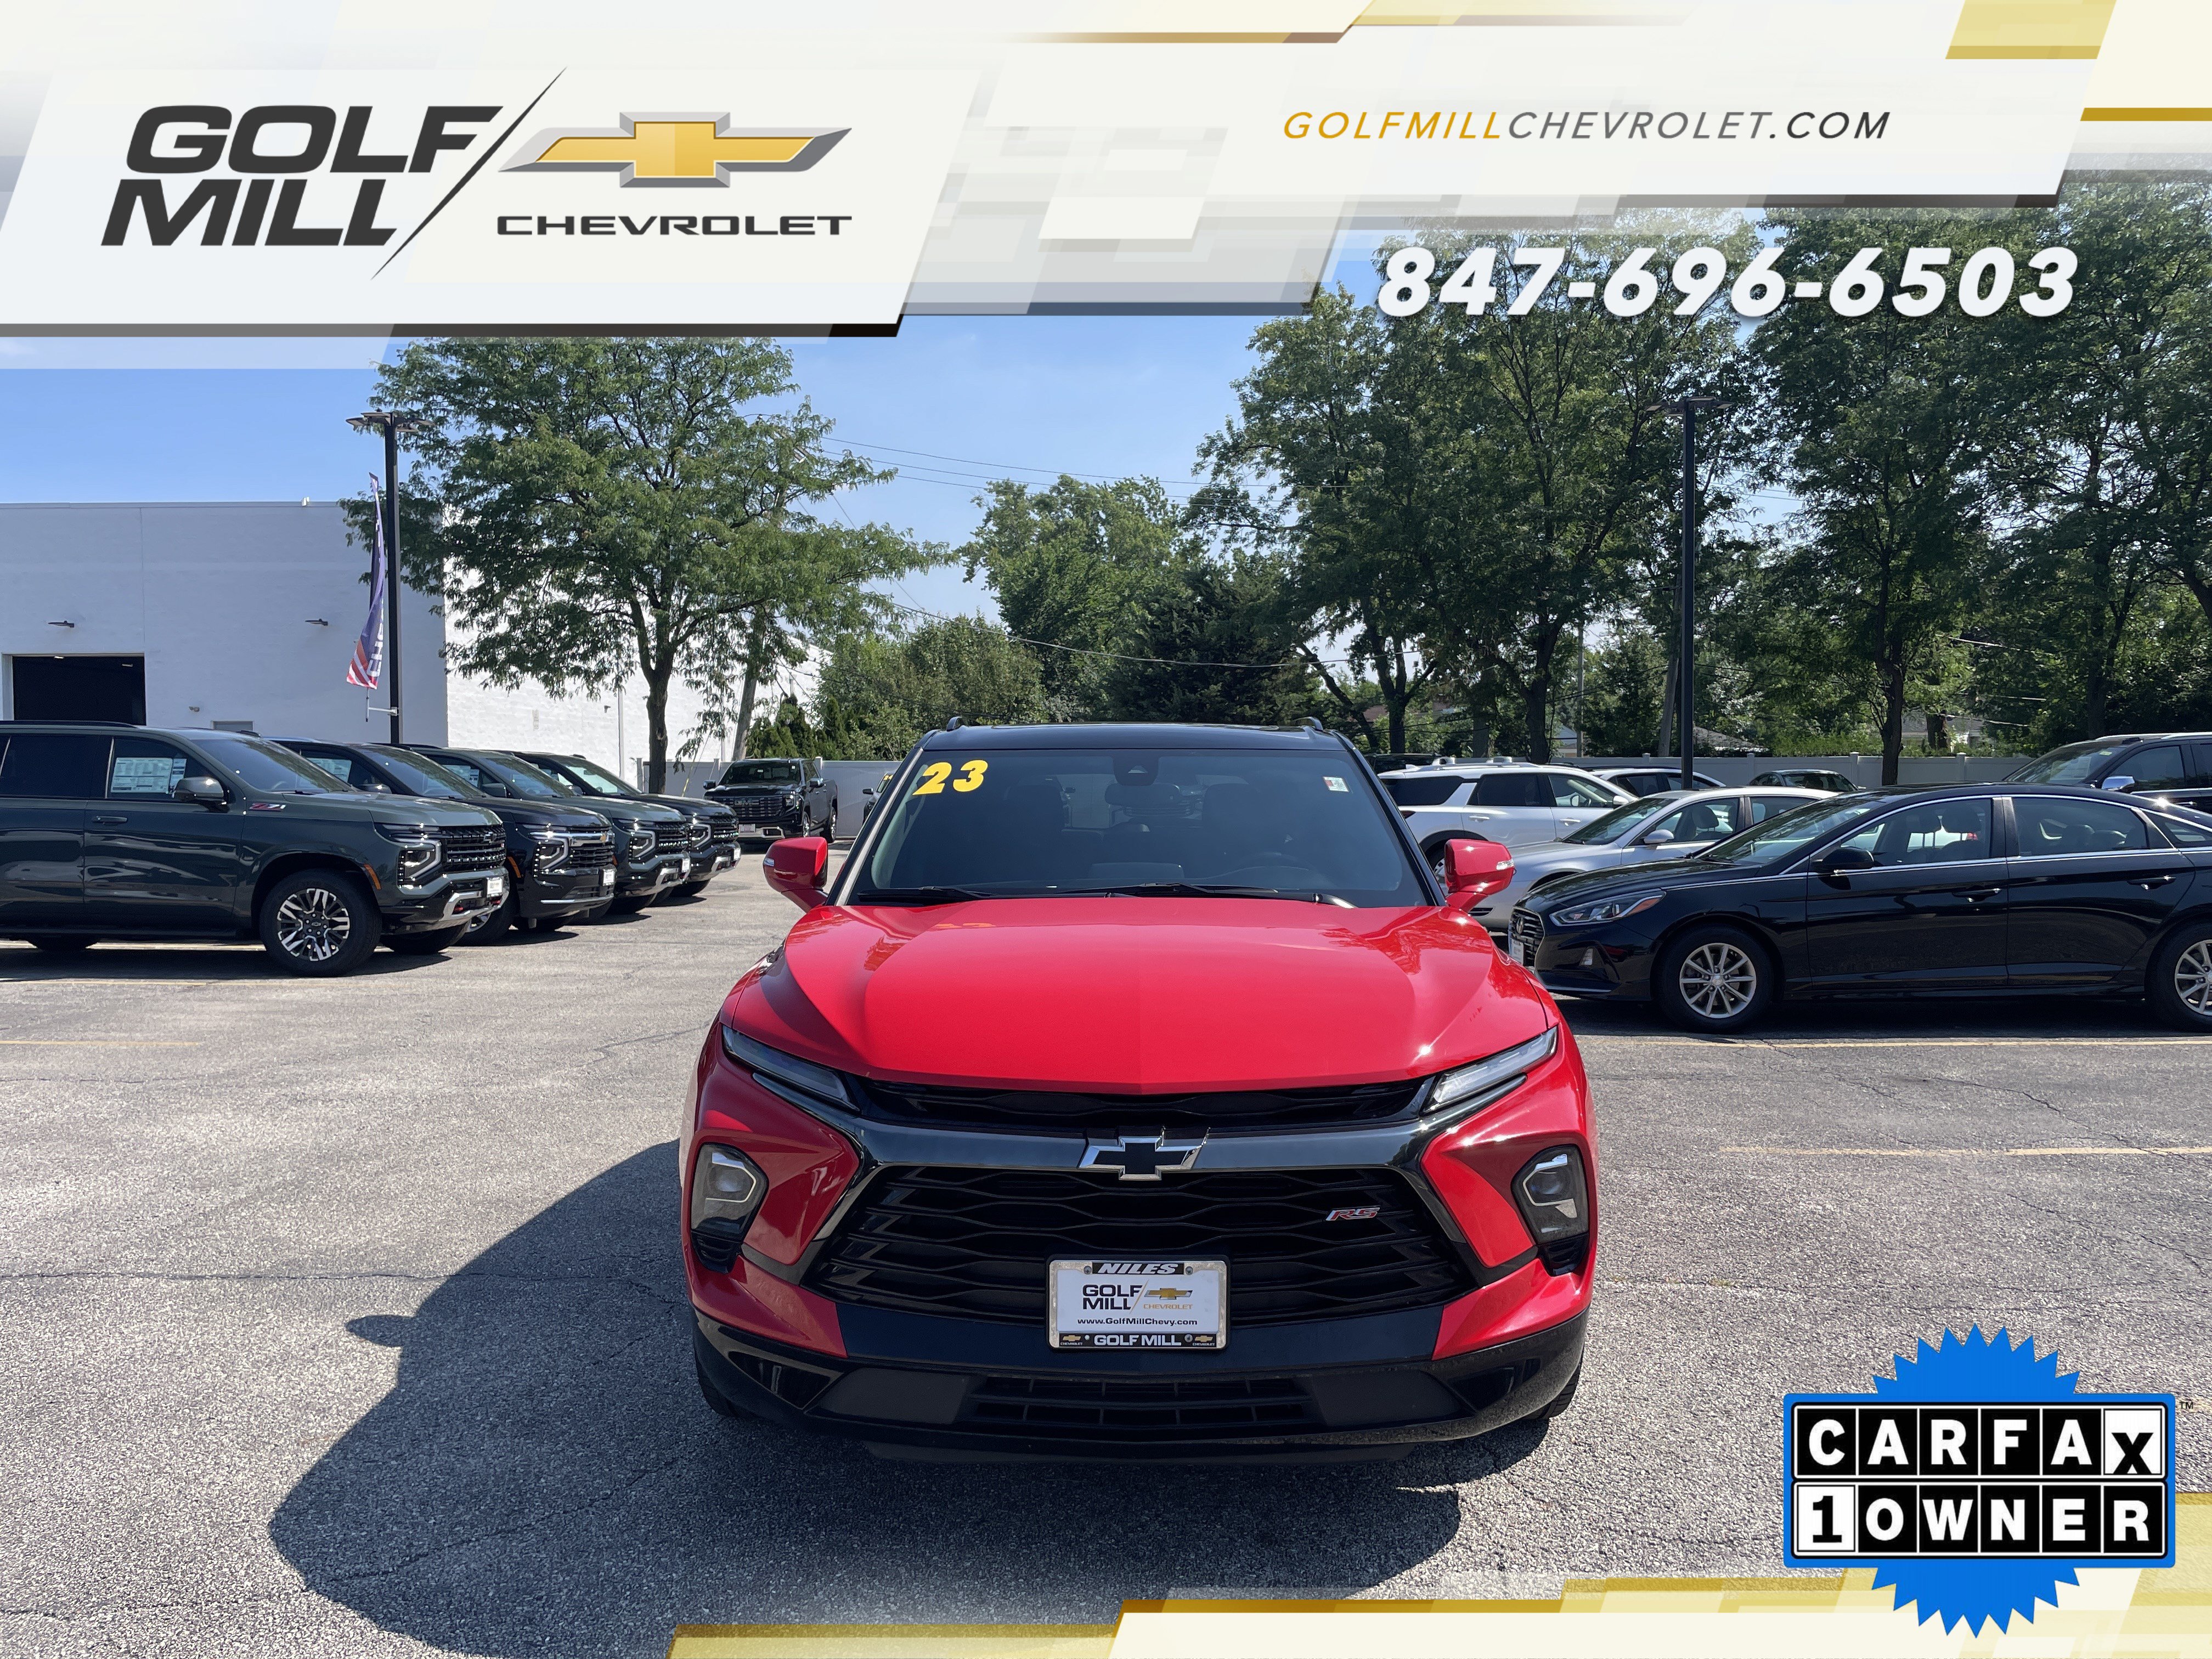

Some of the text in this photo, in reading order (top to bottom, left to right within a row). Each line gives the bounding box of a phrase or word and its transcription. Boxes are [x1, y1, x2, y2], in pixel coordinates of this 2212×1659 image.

[912, 759, 988, 795] 23
[1325, 1207, 1380, 1221] RS
[1097, 1263, 1178, 1274] NILES
[1082, 1284, 1143, 1297] GOLF
[1082, 1297, 1132, 1310] MILL
[1077, 1317, 1198, 1325] www.GolfMillChevy.com
[1094, 1334, 1182, 1346] GOLF MILL
